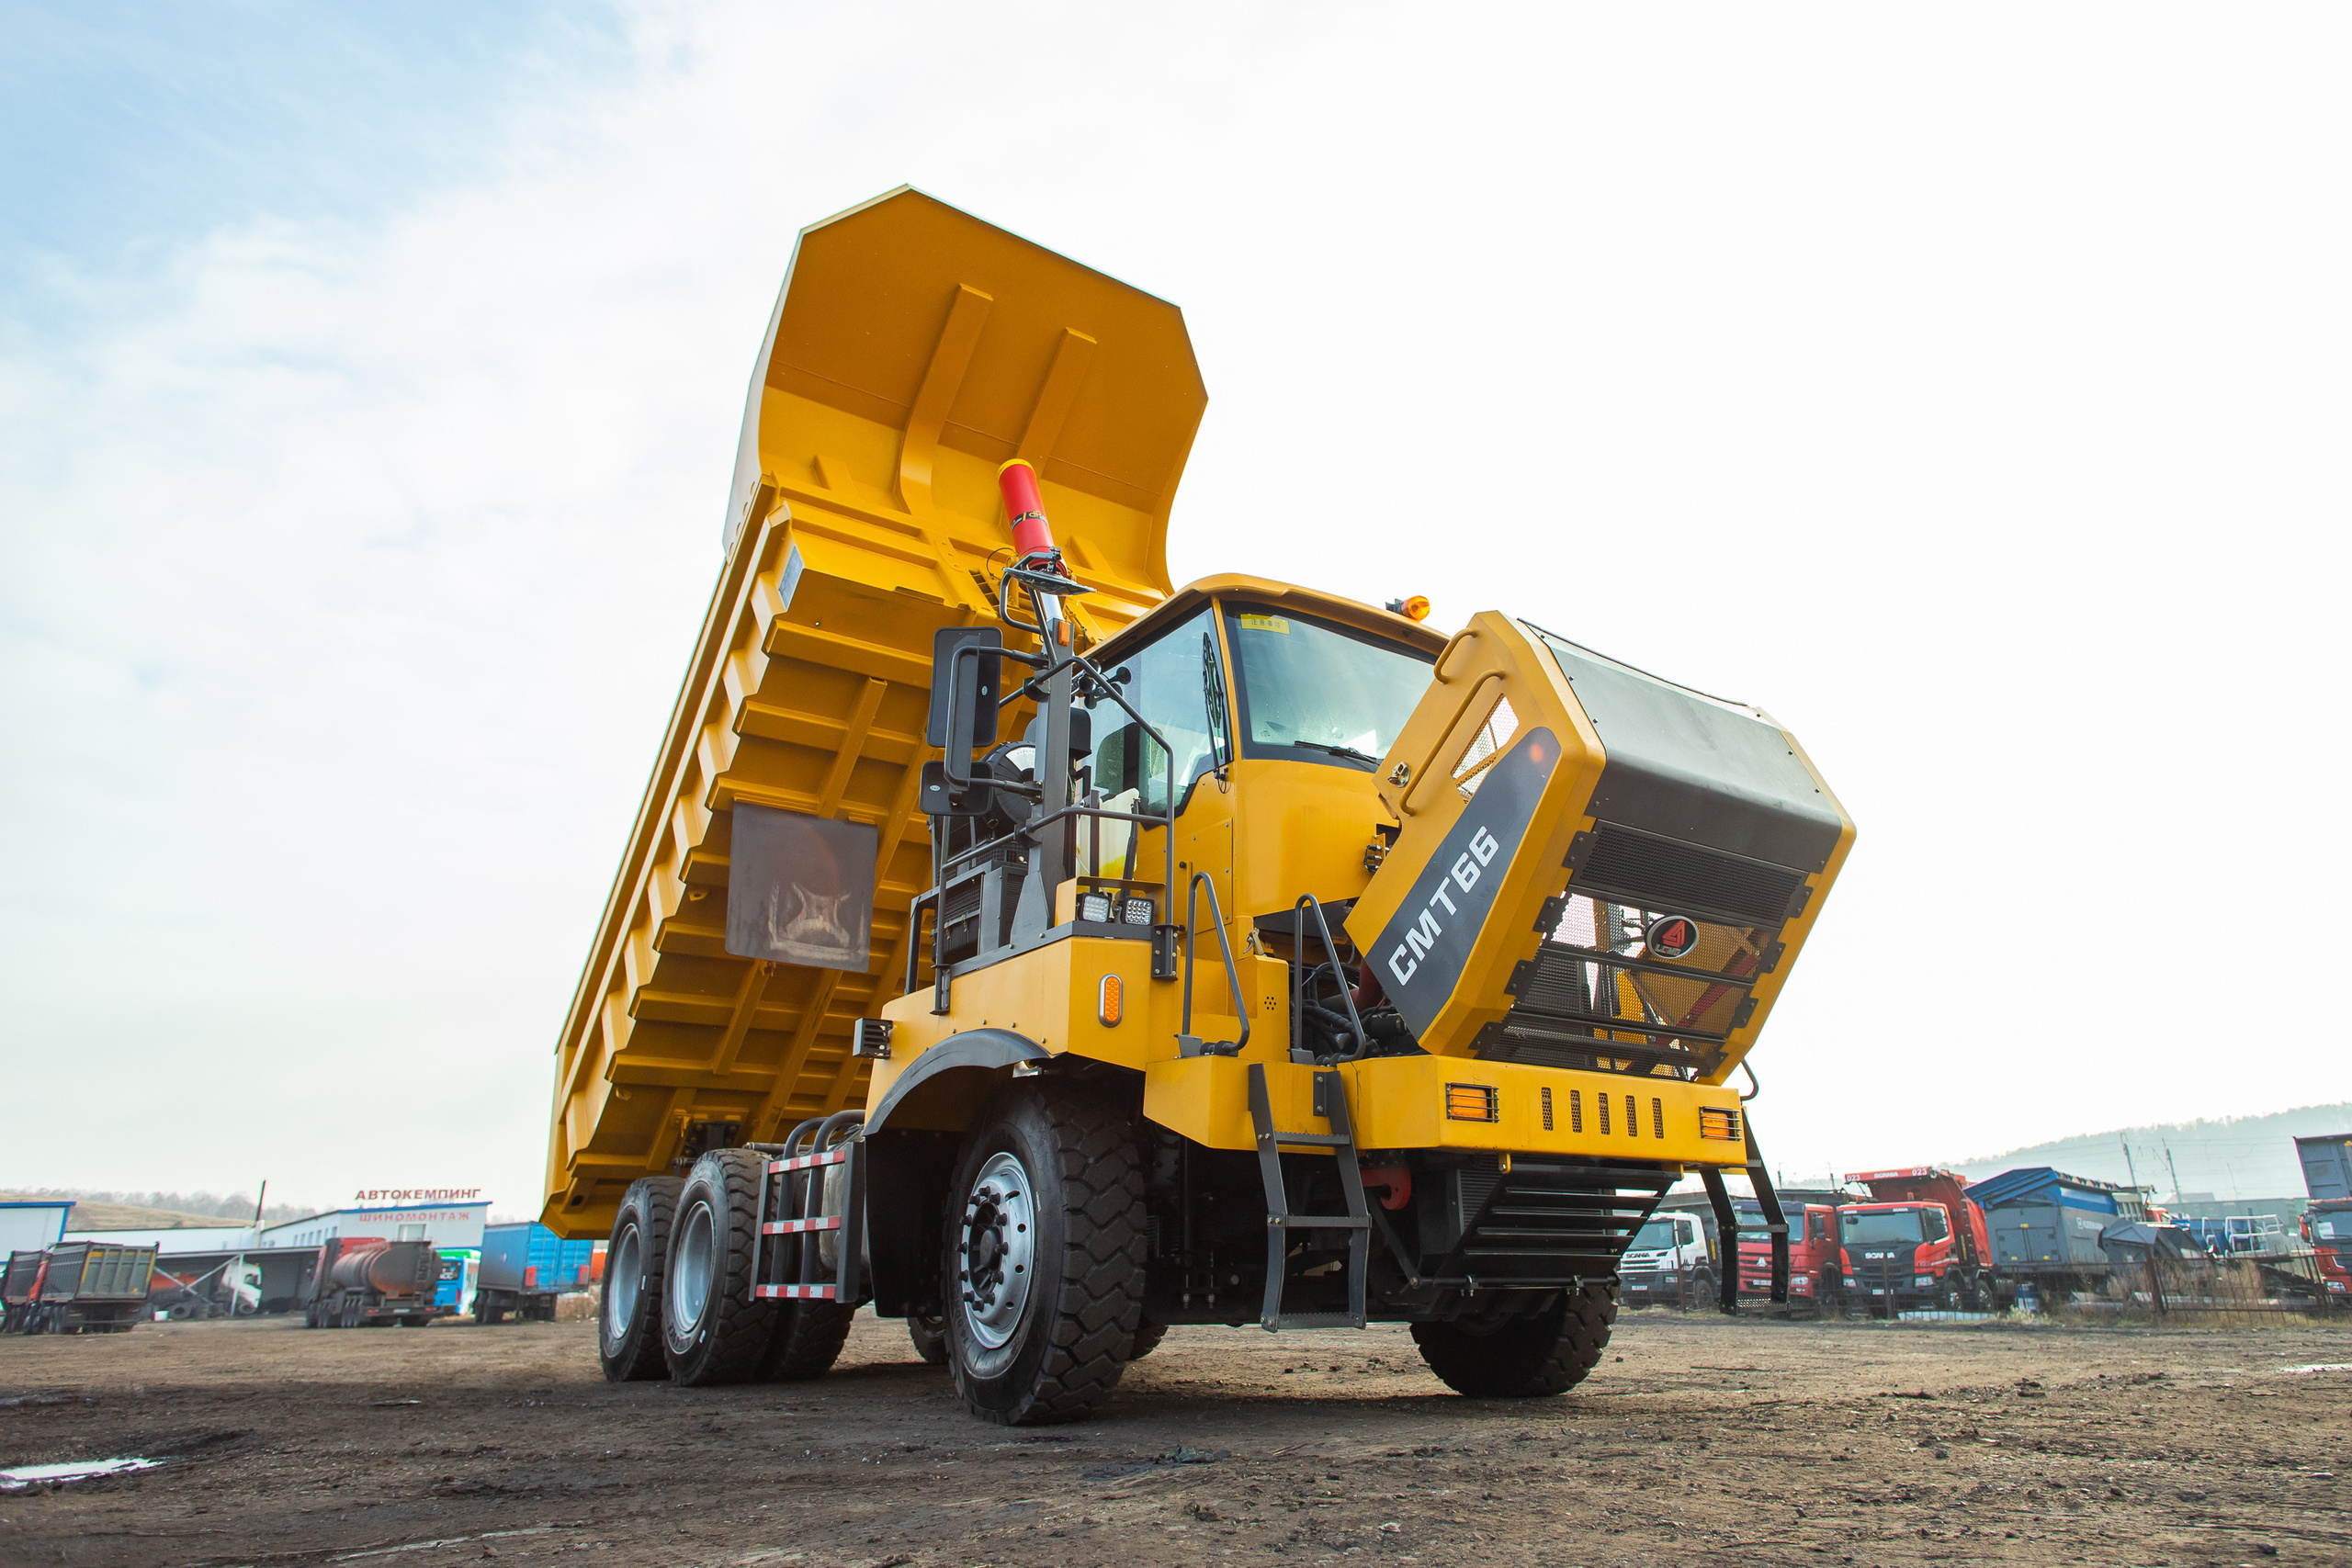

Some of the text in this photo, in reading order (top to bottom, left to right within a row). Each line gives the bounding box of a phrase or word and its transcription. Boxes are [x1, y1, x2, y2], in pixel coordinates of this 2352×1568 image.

[1388, 826, 1499, 986] CMT66
[1912, 1168, 1928, 1177] 023
[355, 1189, 481, 1201] АВТОКЕМПИНГ
[359, 1212, 470, 1223] ШИНОМОНТАЖ
